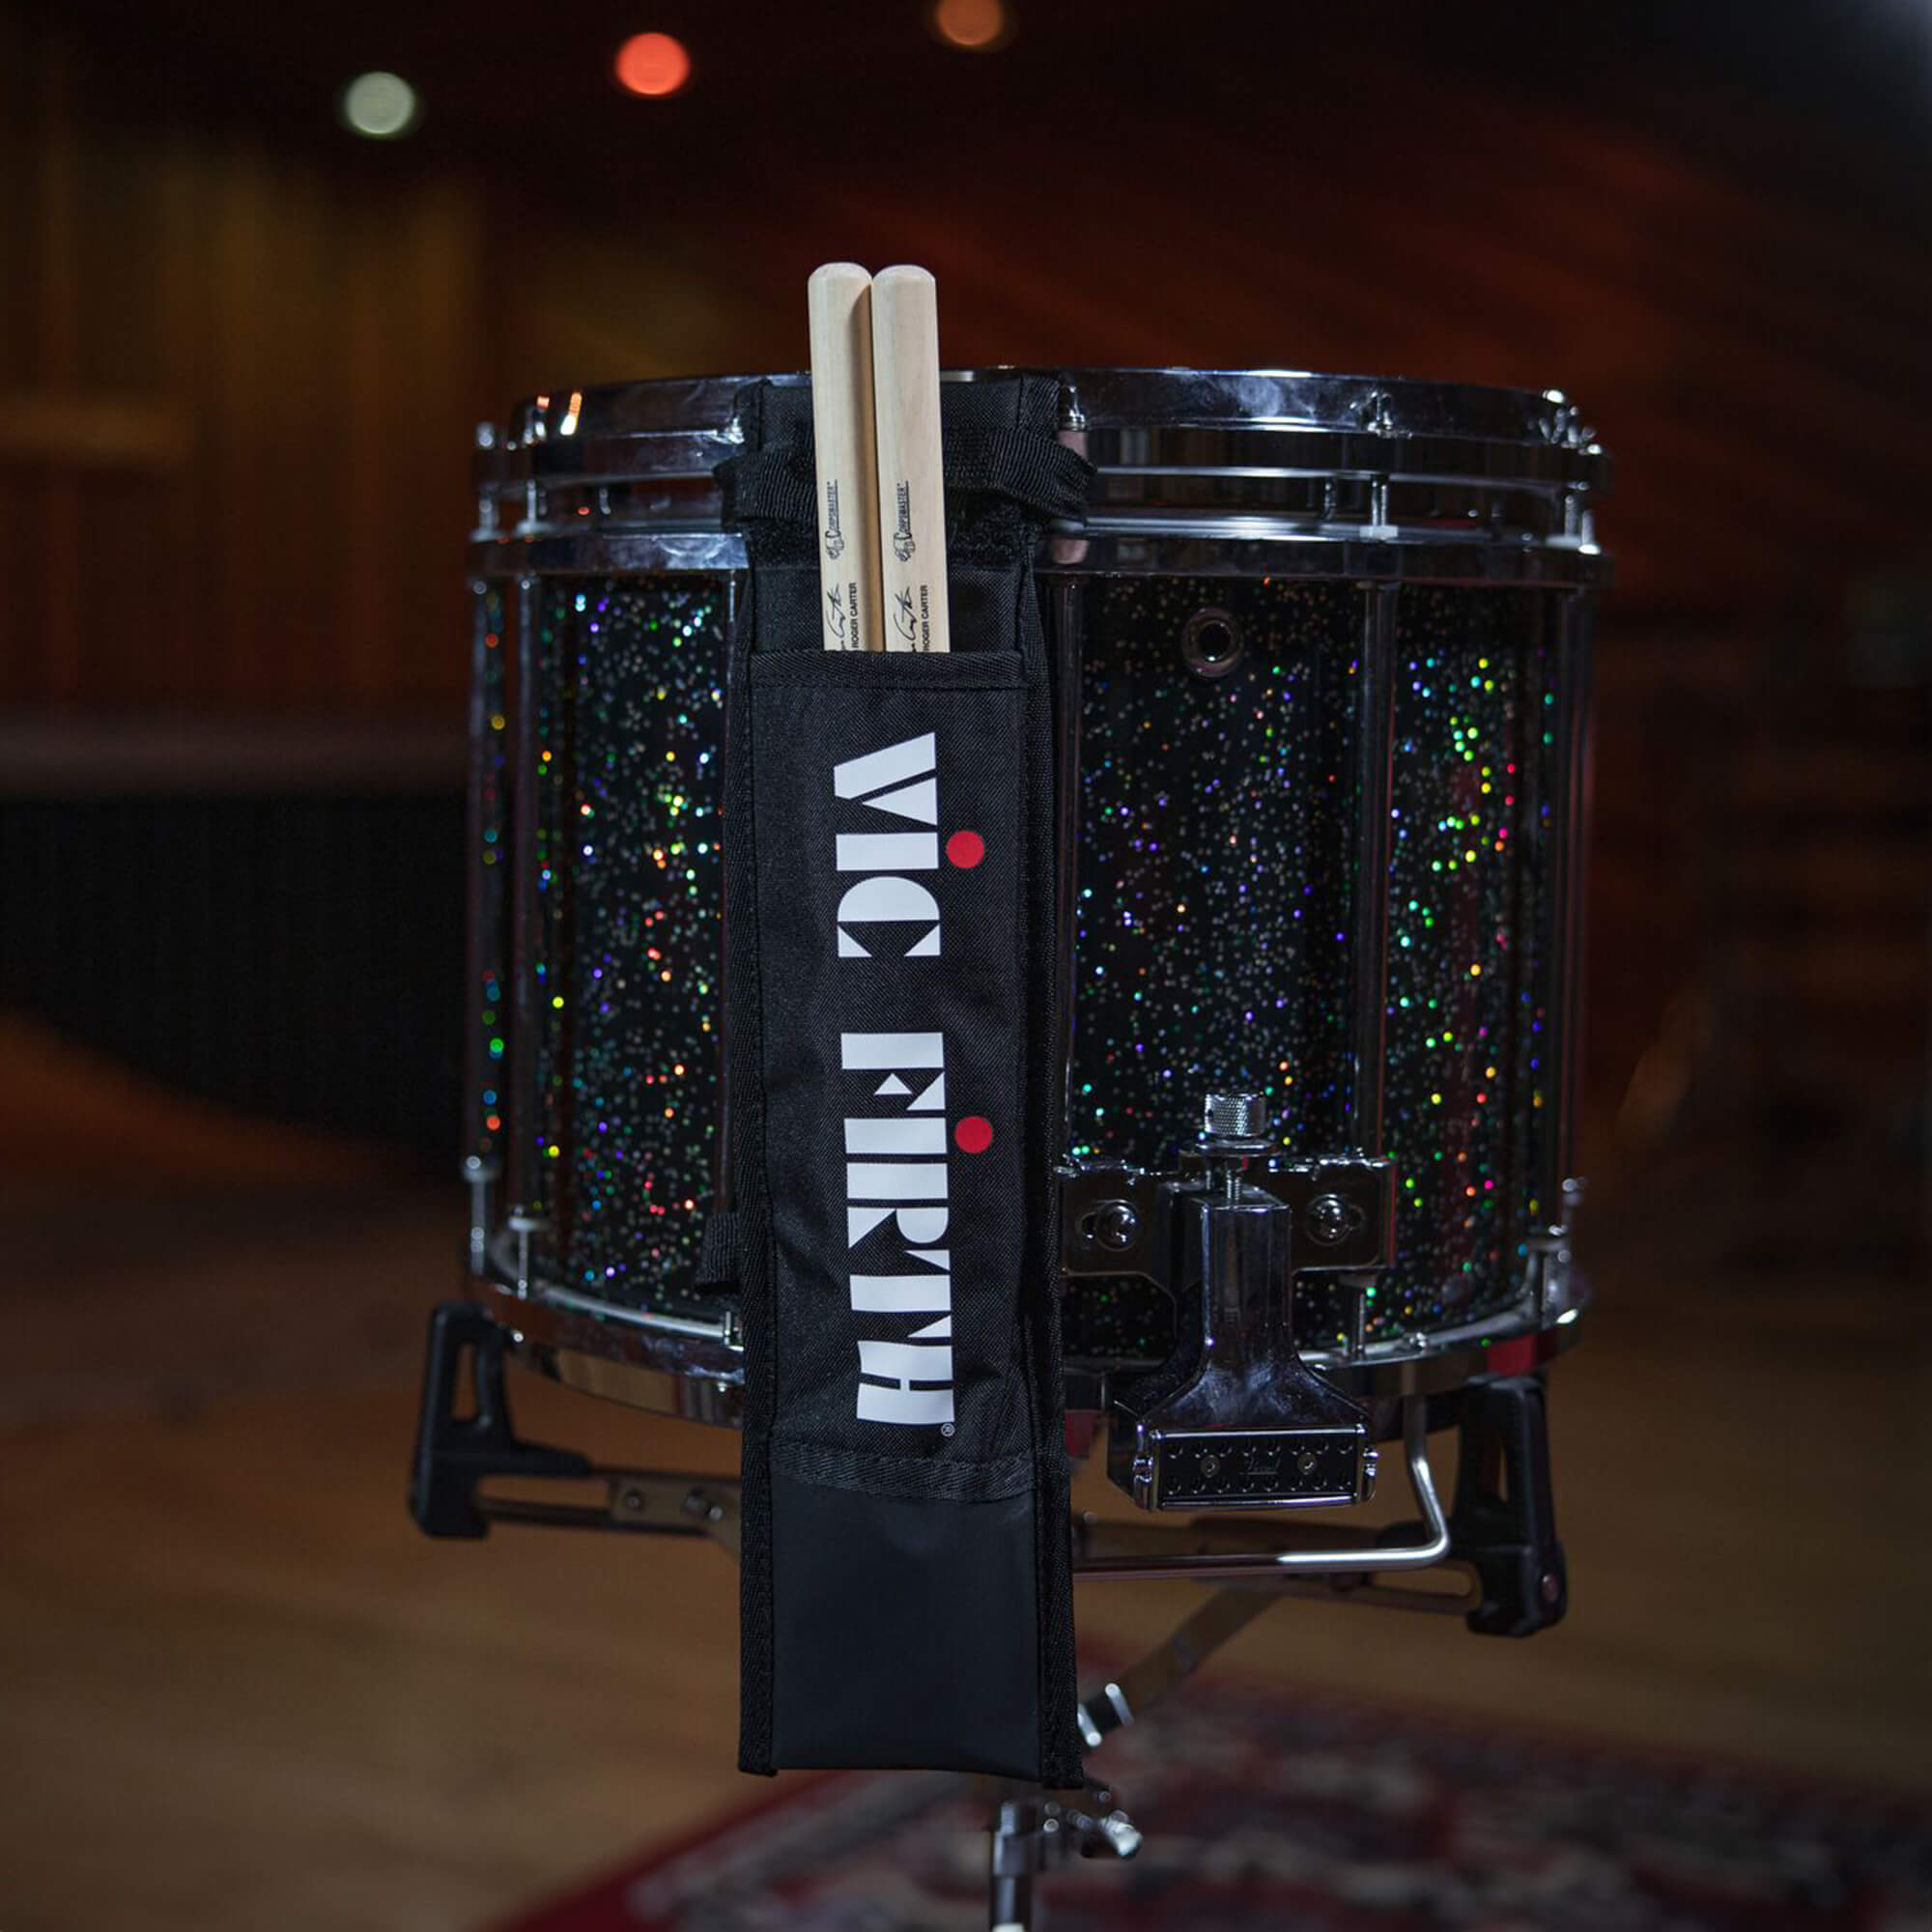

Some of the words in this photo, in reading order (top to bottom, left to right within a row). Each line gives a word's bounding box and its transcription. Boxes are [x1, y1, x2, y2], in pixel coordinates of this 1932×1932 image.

[848, 582, 858, 616] CARTER
[920, 584, 929, 618] CARTER
[849, 617, 859, 648] ROGER
[921, 619, 930, 651] ROGER
